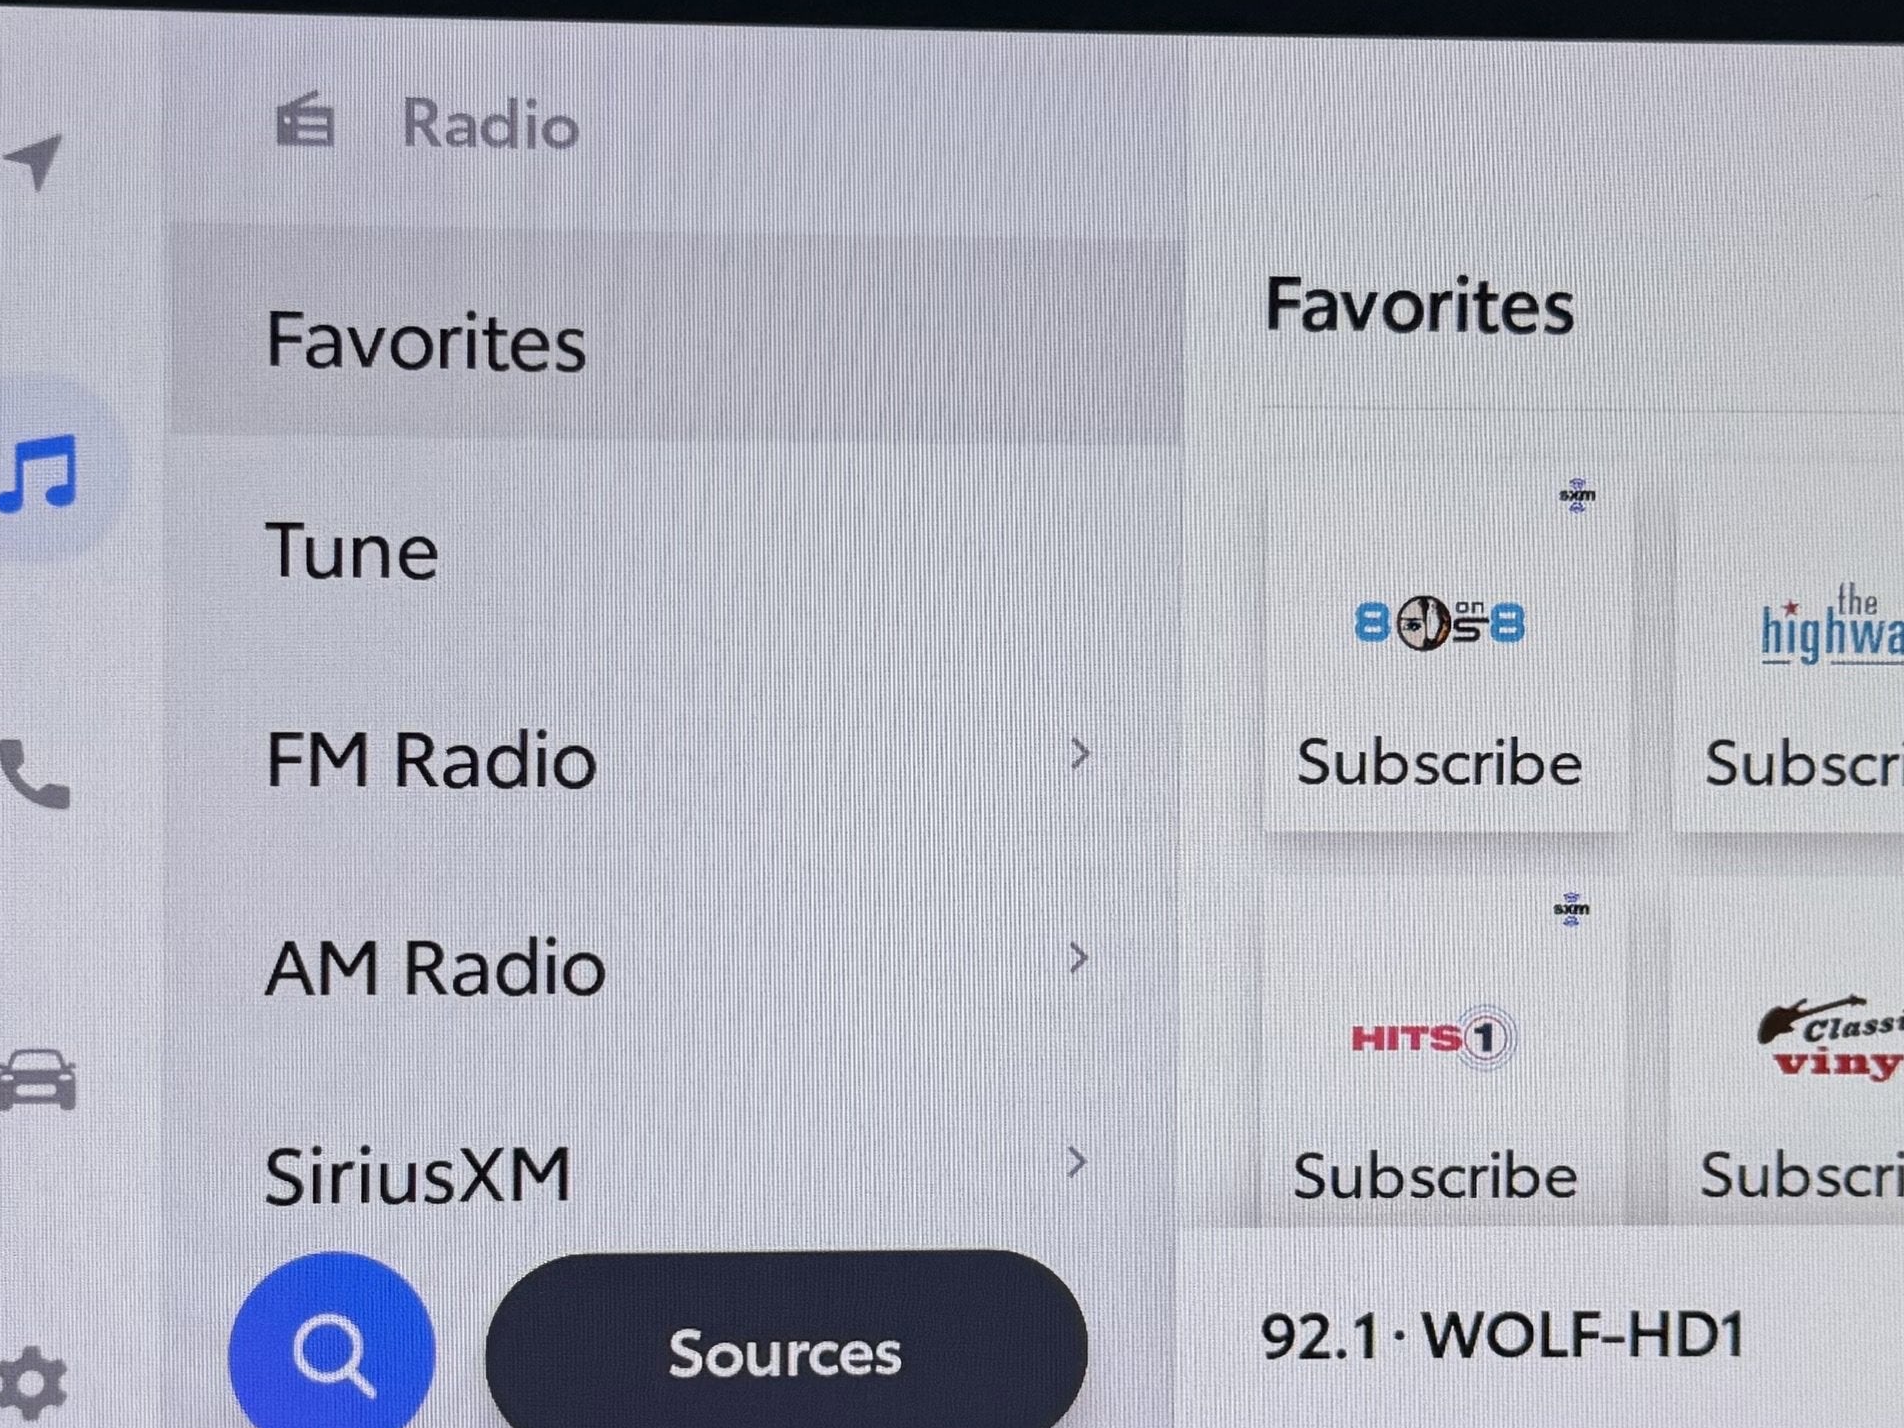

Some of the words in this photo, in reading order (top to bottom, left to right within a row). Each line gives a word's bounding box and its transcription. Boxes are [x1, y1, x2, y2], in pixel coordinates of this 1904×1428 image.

[404, 95, 581, 150] Radio
[1266, 275, 1575, 335] Favorites
[268, 309, 587, 373] Favorites
[264, 521, 439, 581] Tune
[1837, 581, 1879, 616] the
[268, 731, 367, 787] FM
[396, 728, 598, 790] Radio
[1298, 735, 1583, 786] Subscribe
[264, 940, 378, 996] AM
[406, 936, 607, 998] Radio
[266, 1145, 570, 1207] SiriusXM
[1294, 1149, 1578, 1200] Subscribe
[669, 1328, 903, 1378] Sources
[1421, 1310, 1742, 1359] WOLF-HD1
